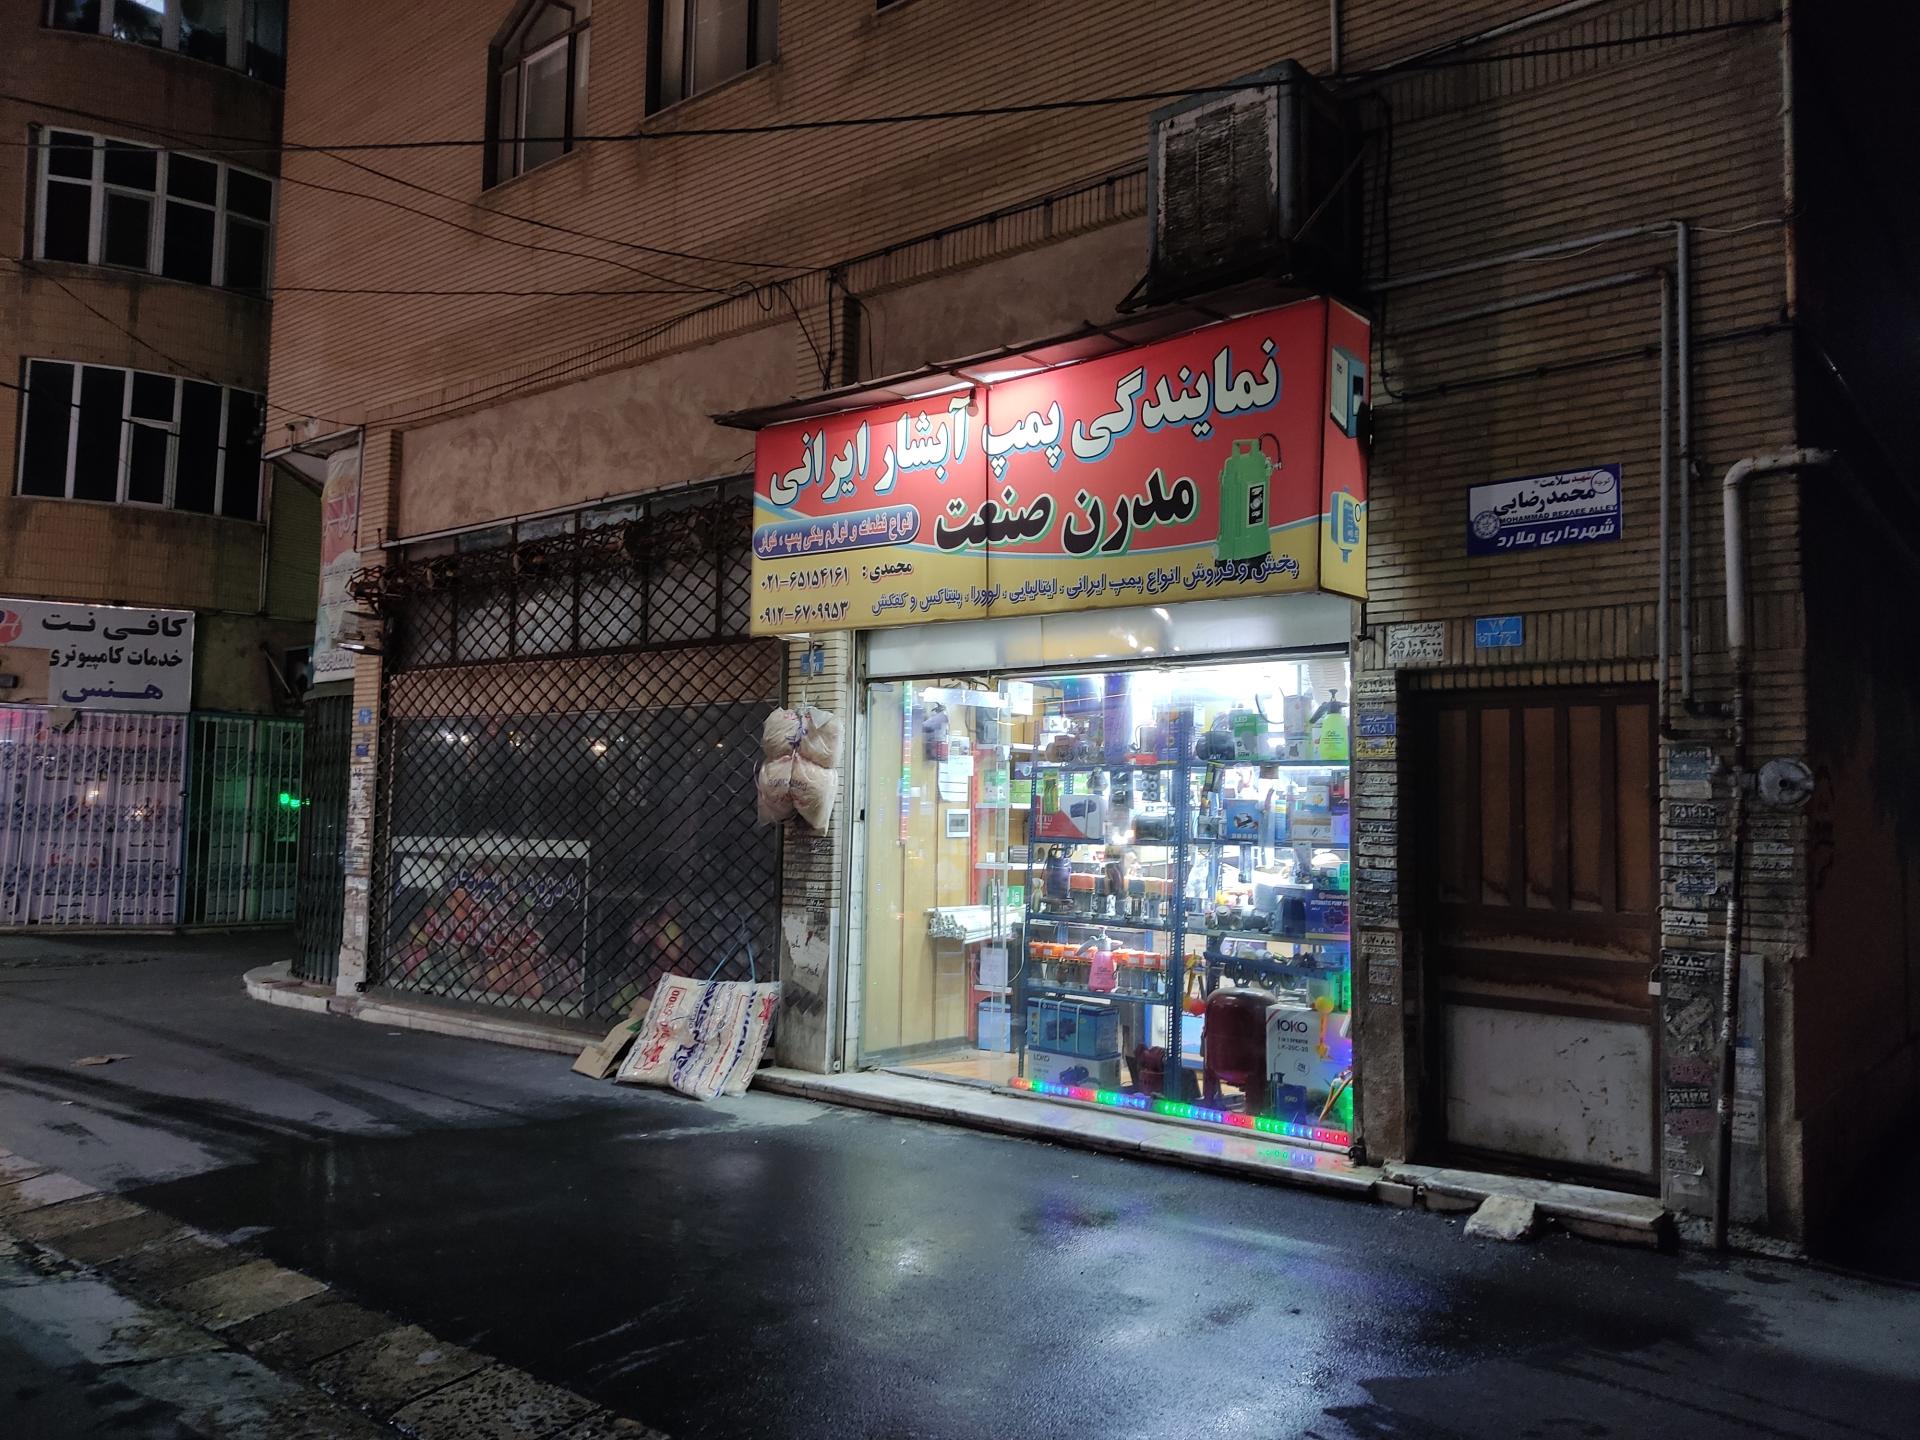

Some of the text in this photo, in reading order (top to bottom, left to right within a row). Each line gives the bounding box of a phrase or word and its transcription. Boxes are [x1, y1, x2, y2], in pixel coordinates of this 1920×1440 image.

[769, 337, 1279, 506] نمایندگی پمپ آبشار ایرانی
[859, 511, 888, 536] قطعات
[934, 466, 1198, 557] مدرن صنعت
[1499, 503, 1618, 524] MOHAMMAD REZAEE ALLEY
[849, 524, 857, 542] و
[888, 510, 914, 540] انواع
[1497, 517, 1616, 549] شهرداری ملارد
[1146, 566, 1180, 594] انواع
[1182, 558, 1238, 589] فروش
[1238, 563, 1250, 583] و
[1251, 553, 1299, 583] پخش
[1108, 574, 1144, 595] پمپ
[871, 592, 909, 615] کفکش
[909, 593, 918, 612] و
[919, 587, 962, 611] پنتاکس
[41, 611, 187, 641] کافی نت
[49, 643, 183, 671] خدمات کامپیوتری
[61, 679, 164, 704] هنس
